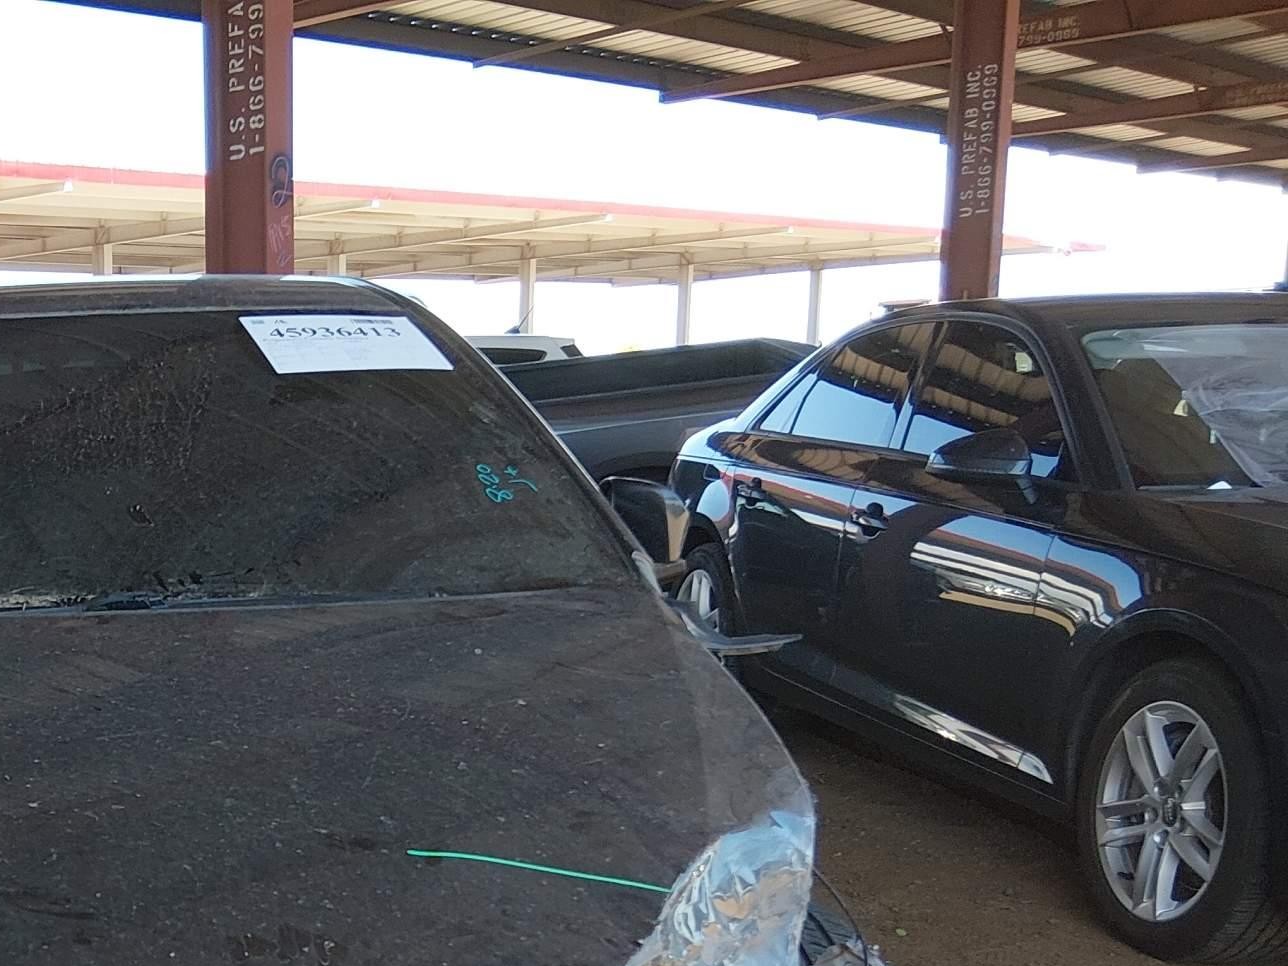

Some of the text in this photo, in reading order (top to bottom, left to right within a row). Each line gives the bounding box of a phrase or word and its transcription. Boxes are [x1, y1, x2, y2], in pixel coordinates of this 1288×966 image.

[227, 1, 246, 161] U.S. PREFA
[248, 4, 265, 154] 1-866-799
[959, 64, 982, 218] U.S. PREFAB INC.
[975, 63, 999, 214] 1-866-799-0969
[268, 326, 402, 339] 45936413
